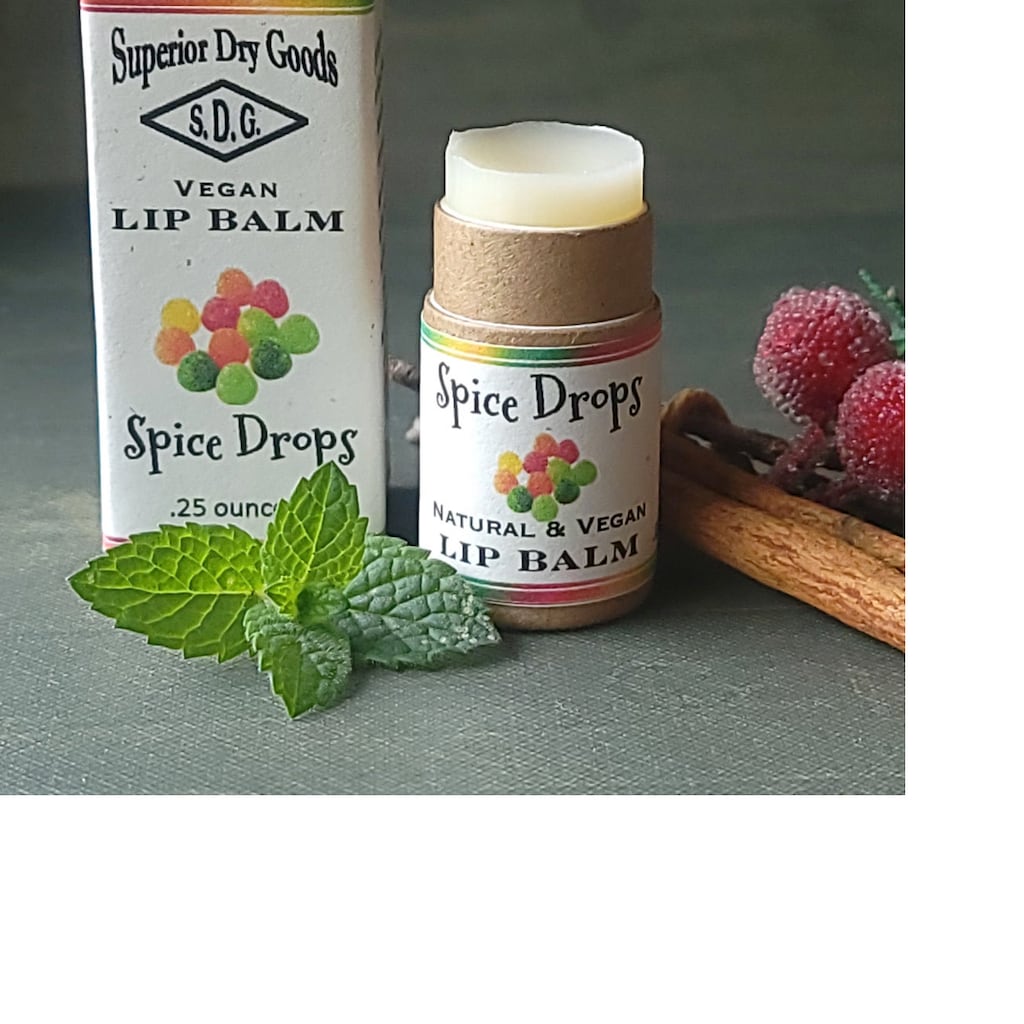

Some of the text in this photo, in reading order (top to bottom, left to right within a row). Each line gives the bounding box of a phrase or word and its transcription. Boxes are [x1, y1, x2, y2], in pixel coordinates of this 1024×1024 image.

[110, 27, 339, 89] Superior Dry Goods
[111, 208, 344, 232] LIP BALM
[436, 361, 643, 433] Spice Drops
[124, 413, 358, 476] Spice Drops
[170, 498, 277, 518] .25 ounc
[546, 521, 566, 537] &
[439, 533, 639, 572] LIP BALM
